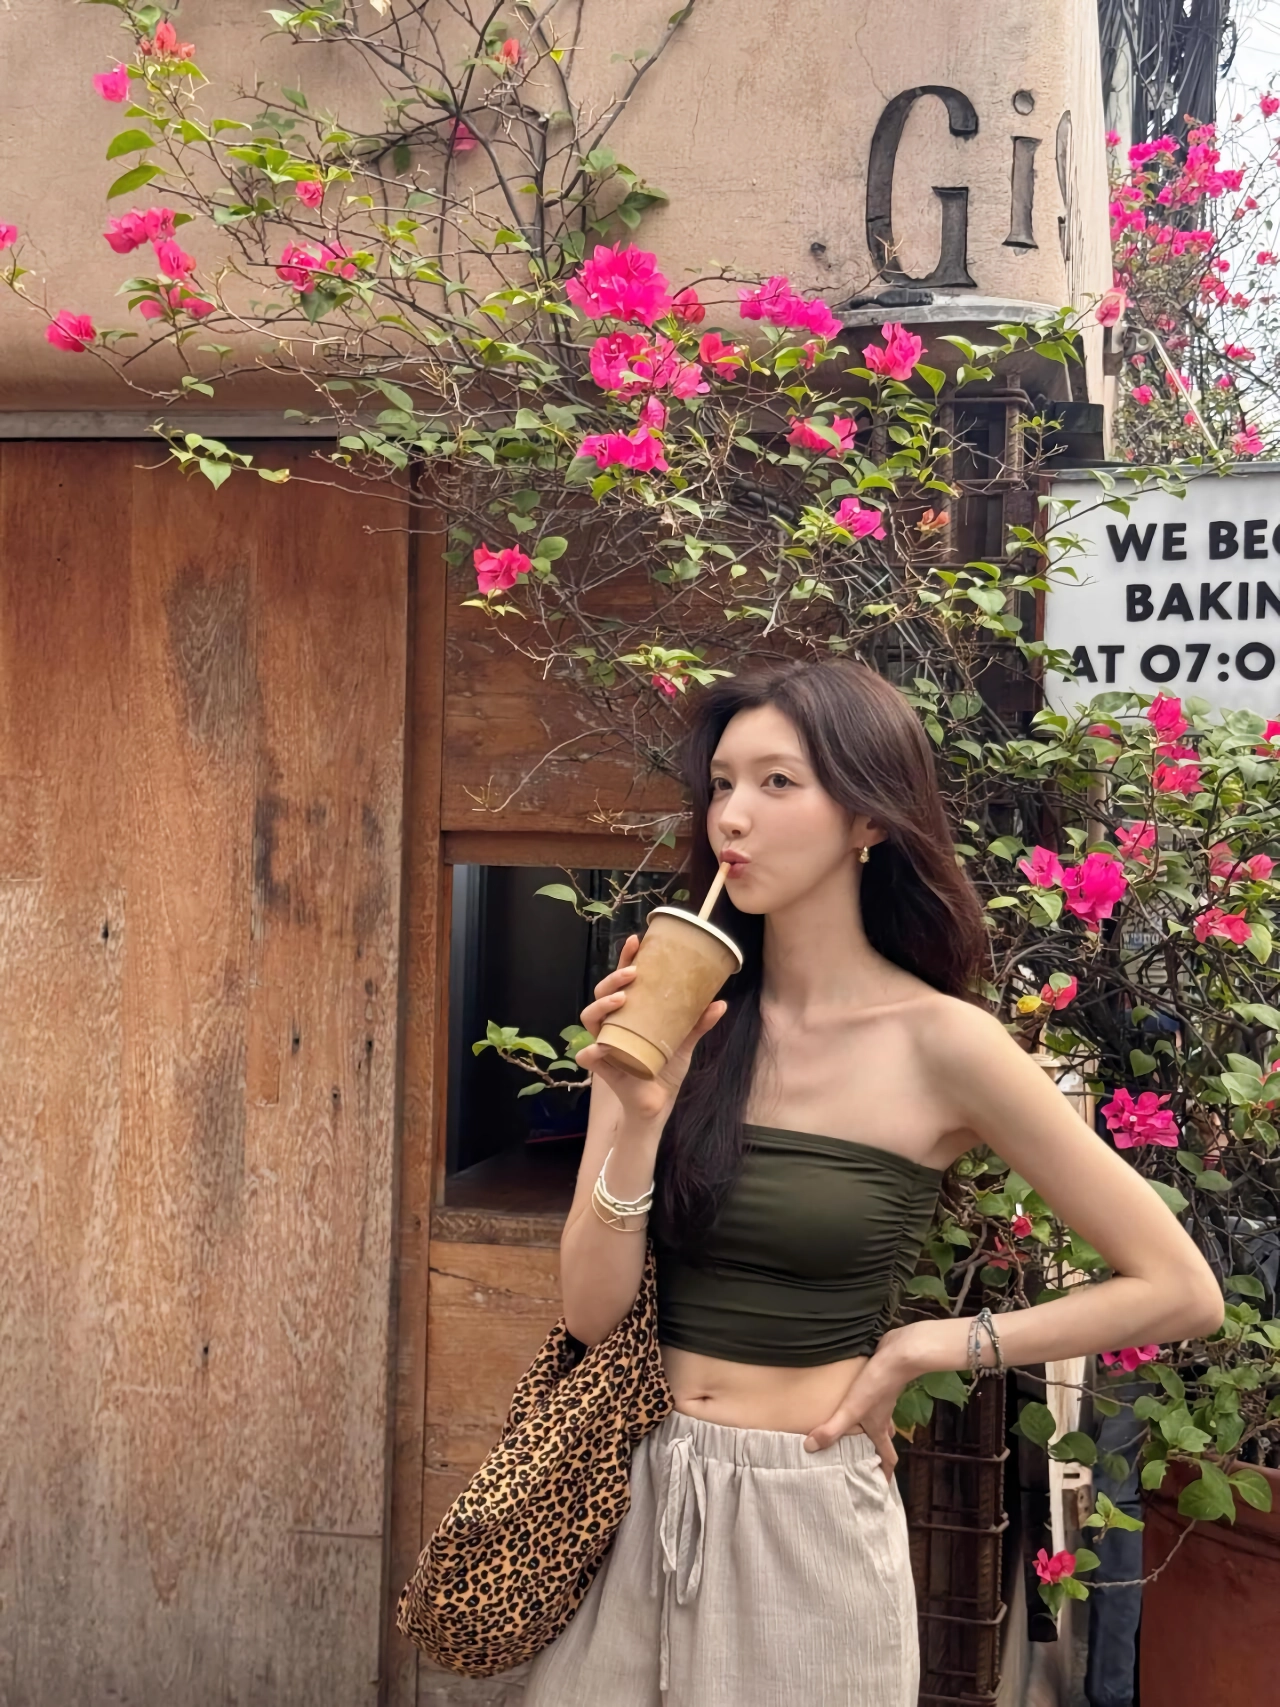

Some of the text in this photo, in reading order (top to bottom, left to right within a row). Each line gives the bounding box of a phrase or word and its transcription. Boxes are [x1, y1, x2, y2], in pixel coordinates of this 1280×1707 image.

[866, 85, 1072, 288] Gi
[1106, 519, 1280, 562] WE BE
[1126, 581, 1280, 622] BAKIN
[1063, 645, 1125, 683] AT
